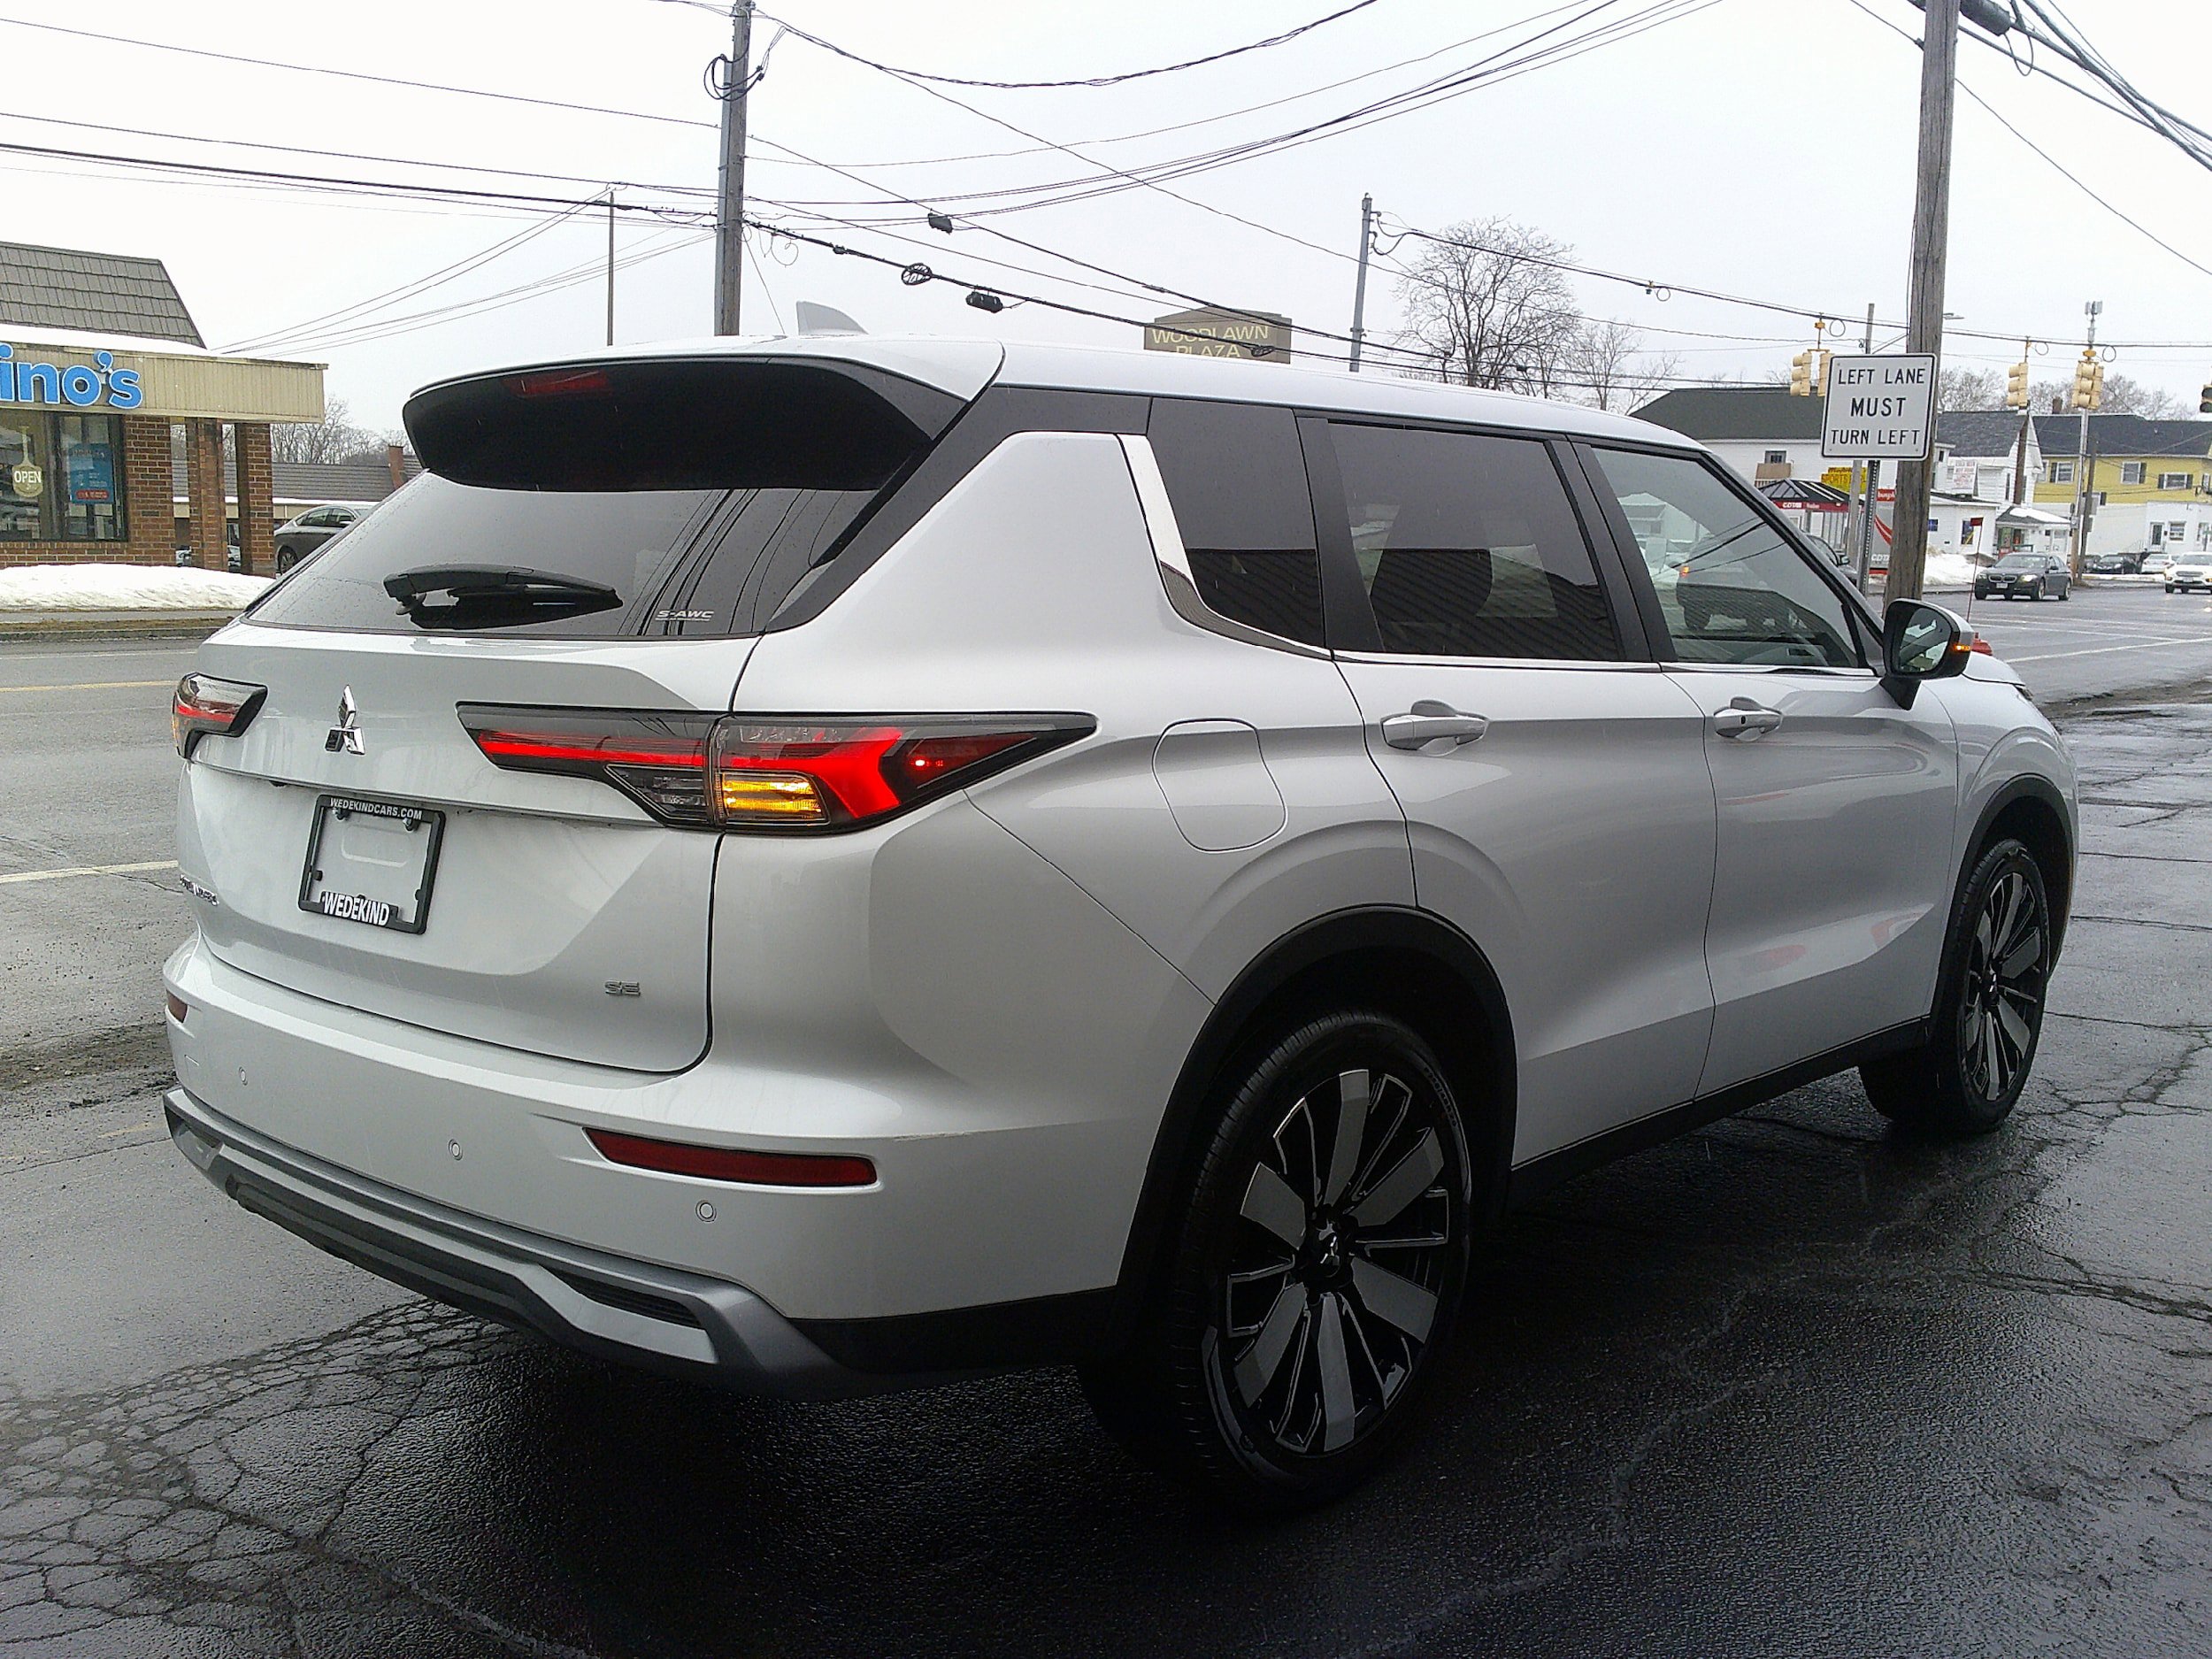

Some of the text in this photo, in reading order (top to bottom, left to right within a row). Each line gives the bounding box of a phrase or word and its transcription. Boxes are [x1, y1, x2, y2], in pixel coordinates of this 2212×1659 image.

[1838, 368, 1925, 384] LEFT LANE
[1850, 397, 1907, 417] MUST
[1831, 429, 1920, 444] TURN LEFT
[13, 470, 42, 484] OPEN
[657, 610, 715, 618] S-AWC
[330, 797, 423, 820] WEDEKINDCARS.COM
[323, 892, 390, 926] WEDEKIND
[603, 979, 641, 995] SE
